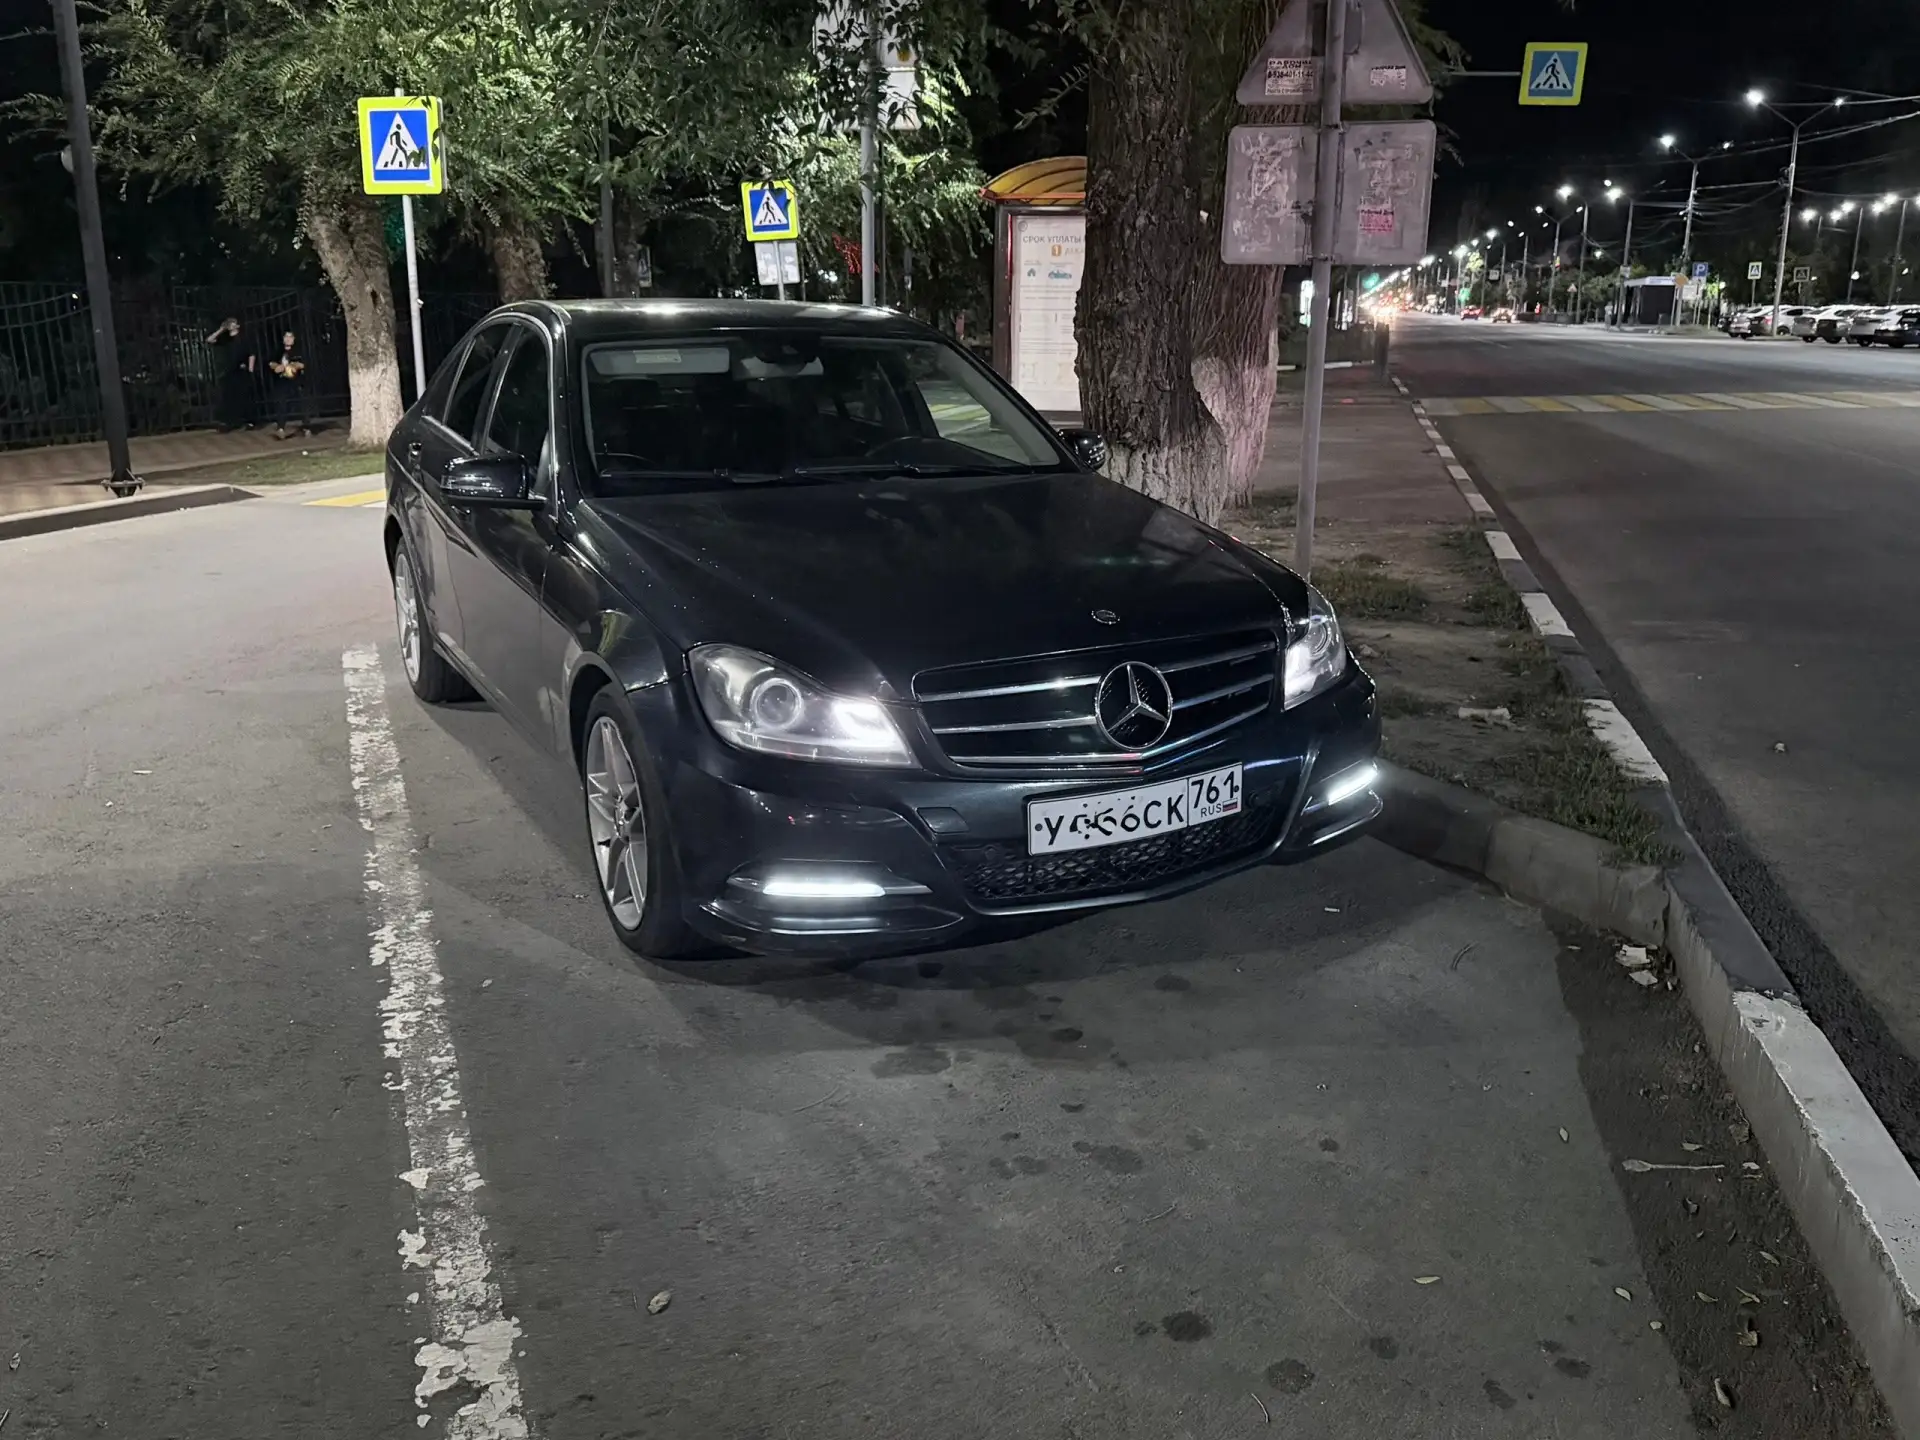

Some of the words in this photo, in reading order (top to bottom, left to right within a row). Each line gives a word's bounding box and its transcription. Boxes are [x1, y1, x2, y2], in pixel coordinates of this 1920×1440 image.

[1022, 235, 1045, 243] СРОК
[1047, 235, 1081, 244] УПЛАТЫ
[1191, 771, 1235, 809] 761
[1200, 803, 1222, 818] RUS
